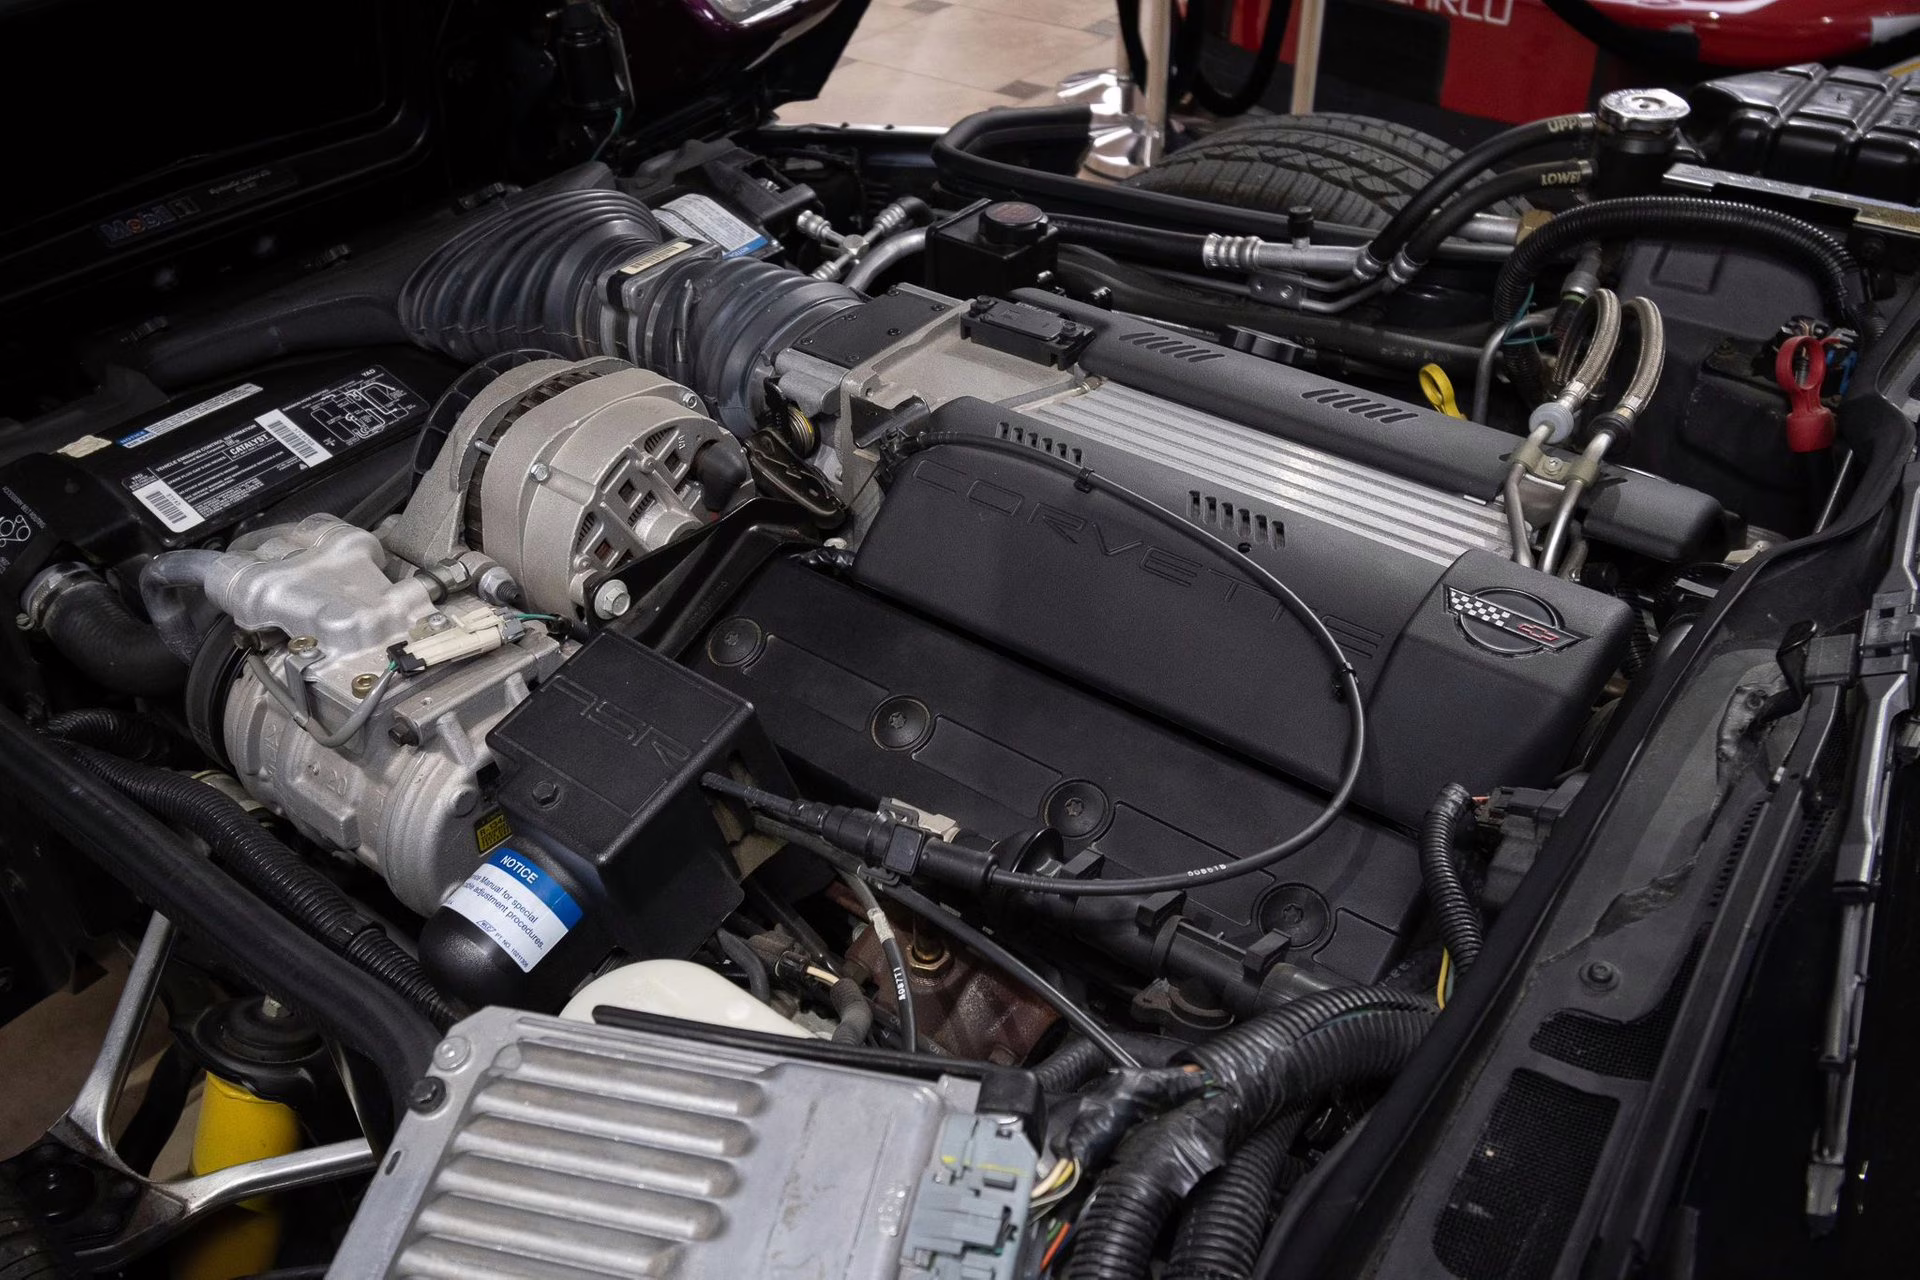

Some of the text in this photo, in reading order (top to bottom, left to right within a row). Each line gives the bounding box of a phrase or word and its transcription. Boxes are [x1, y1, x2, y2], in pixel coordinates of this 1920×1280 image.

[228, 433, 269, 455] CATALYST
[499, 852, 539, 885] NOTICE
[471, 884, 508, 914] adjustment
[506, 910, 543, 950] procedures.
[479, 874, 503, 895] Manual
[500, 888, 514, 902] for
[508, 898, 539, 924] special
